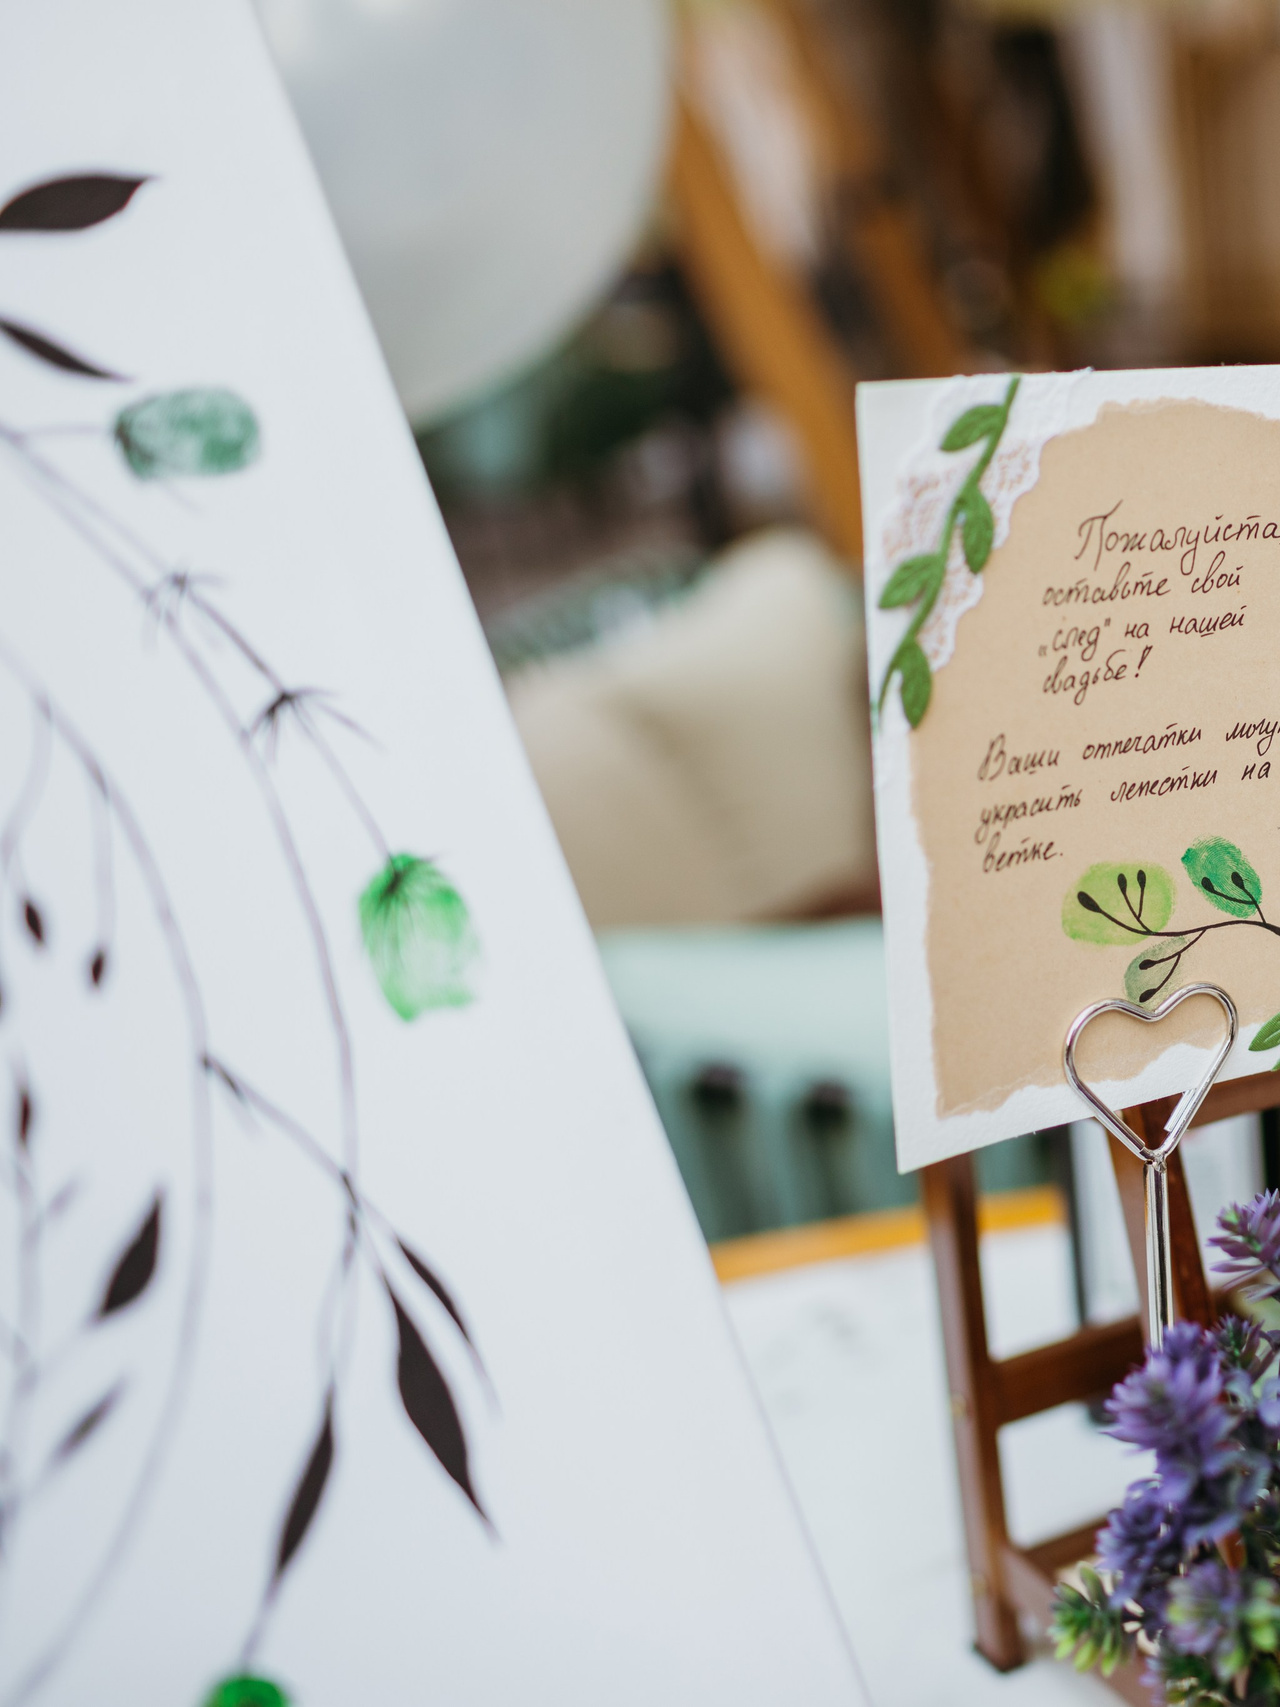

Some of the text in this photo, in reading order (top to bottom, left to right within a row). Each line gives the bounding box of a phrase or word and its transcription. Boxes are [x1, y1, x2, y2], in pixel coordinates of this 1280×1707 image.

[1042, 550, 1244, 607] оставьте свой
[1125, 622, 1150, 638] на
[1169, 605, 1247, 638] нашей
[1042, 645, 1153, 705] свадьбе!
[977, 733, 1059, 781] Ваши
[1082, 722, 1201, 761] отпечатки
[974, 761, 1271, 844] украсить лепестки на
[982, 832, 1063, 873] ветке.
